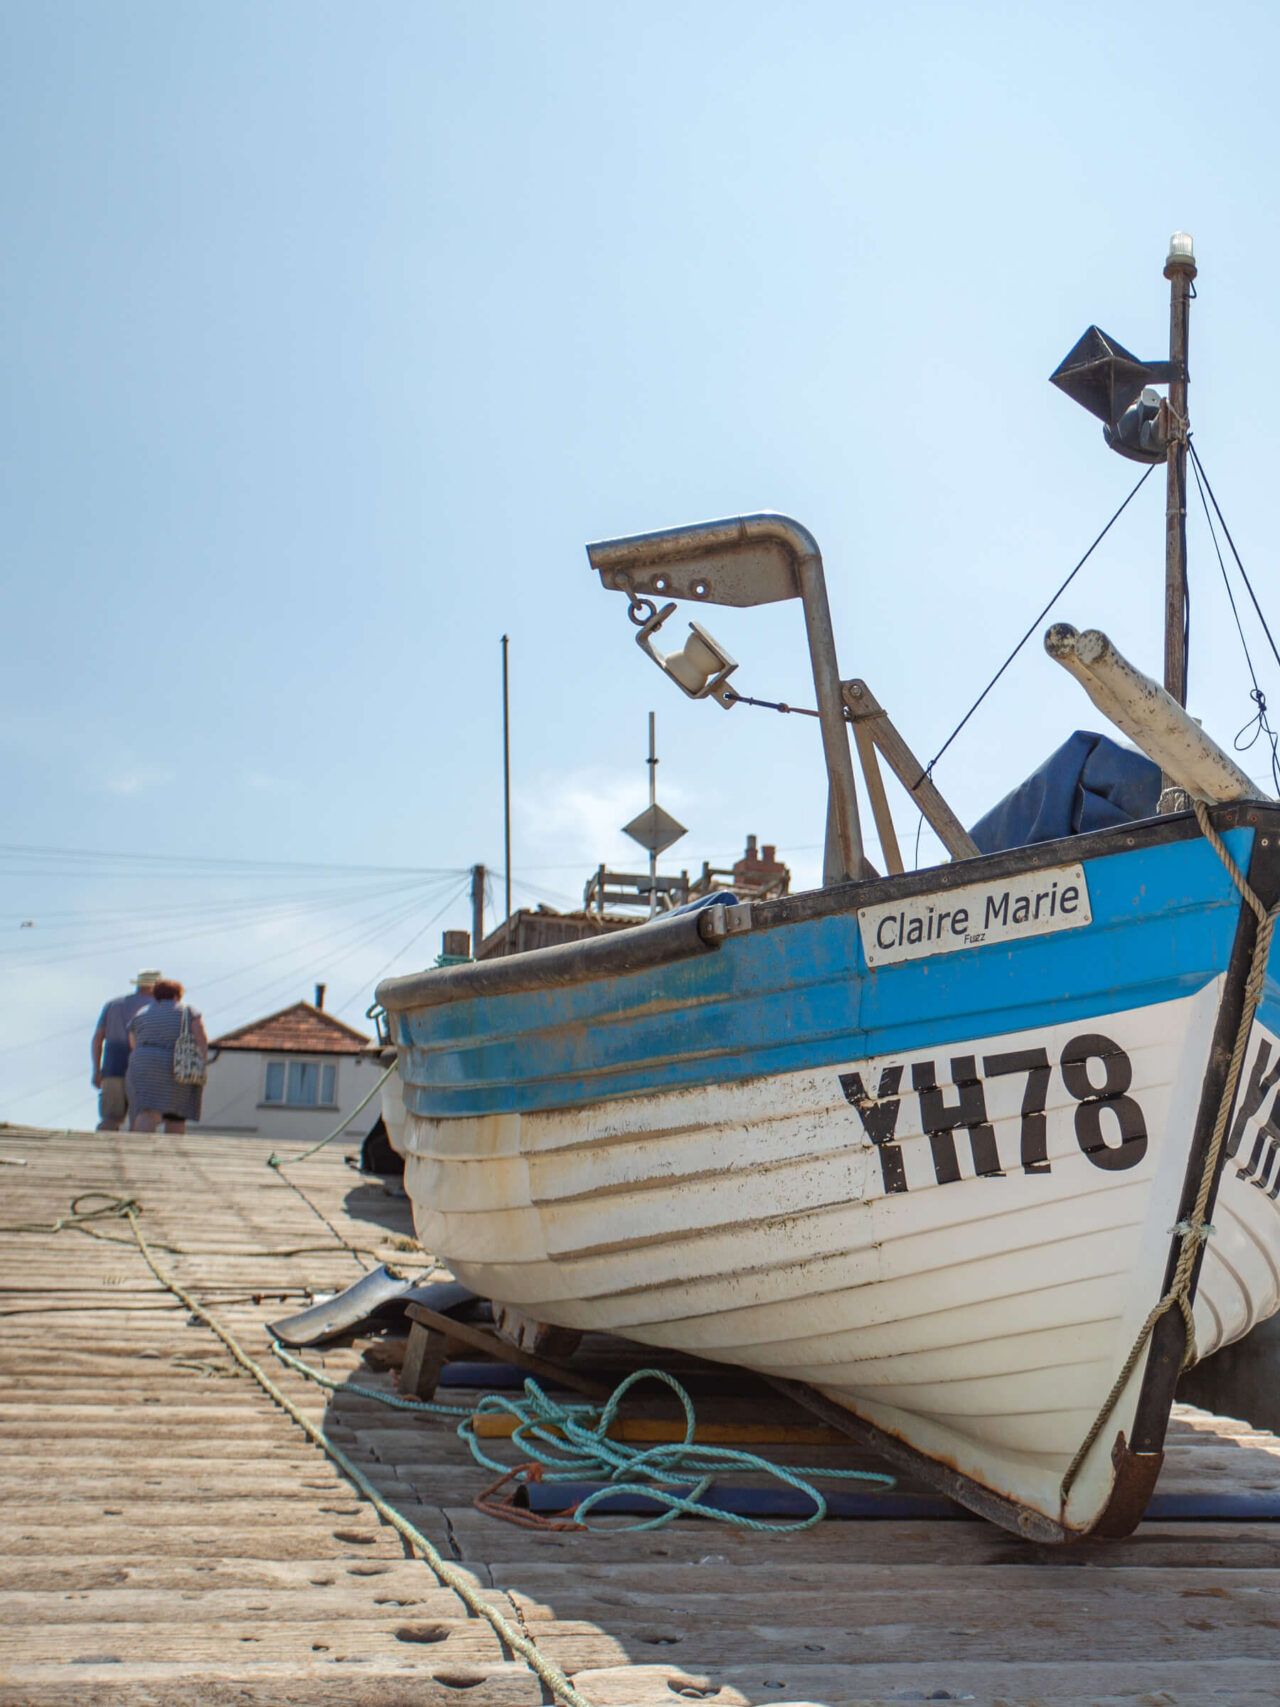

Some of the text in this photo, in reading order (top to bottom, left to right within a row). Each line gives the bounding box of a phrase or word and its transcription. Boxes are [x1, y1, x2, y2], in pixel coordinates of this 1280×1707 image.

[876, 882, 1079, 950] Claire Marie
[838, 1033, 1148, 1194] YH78
